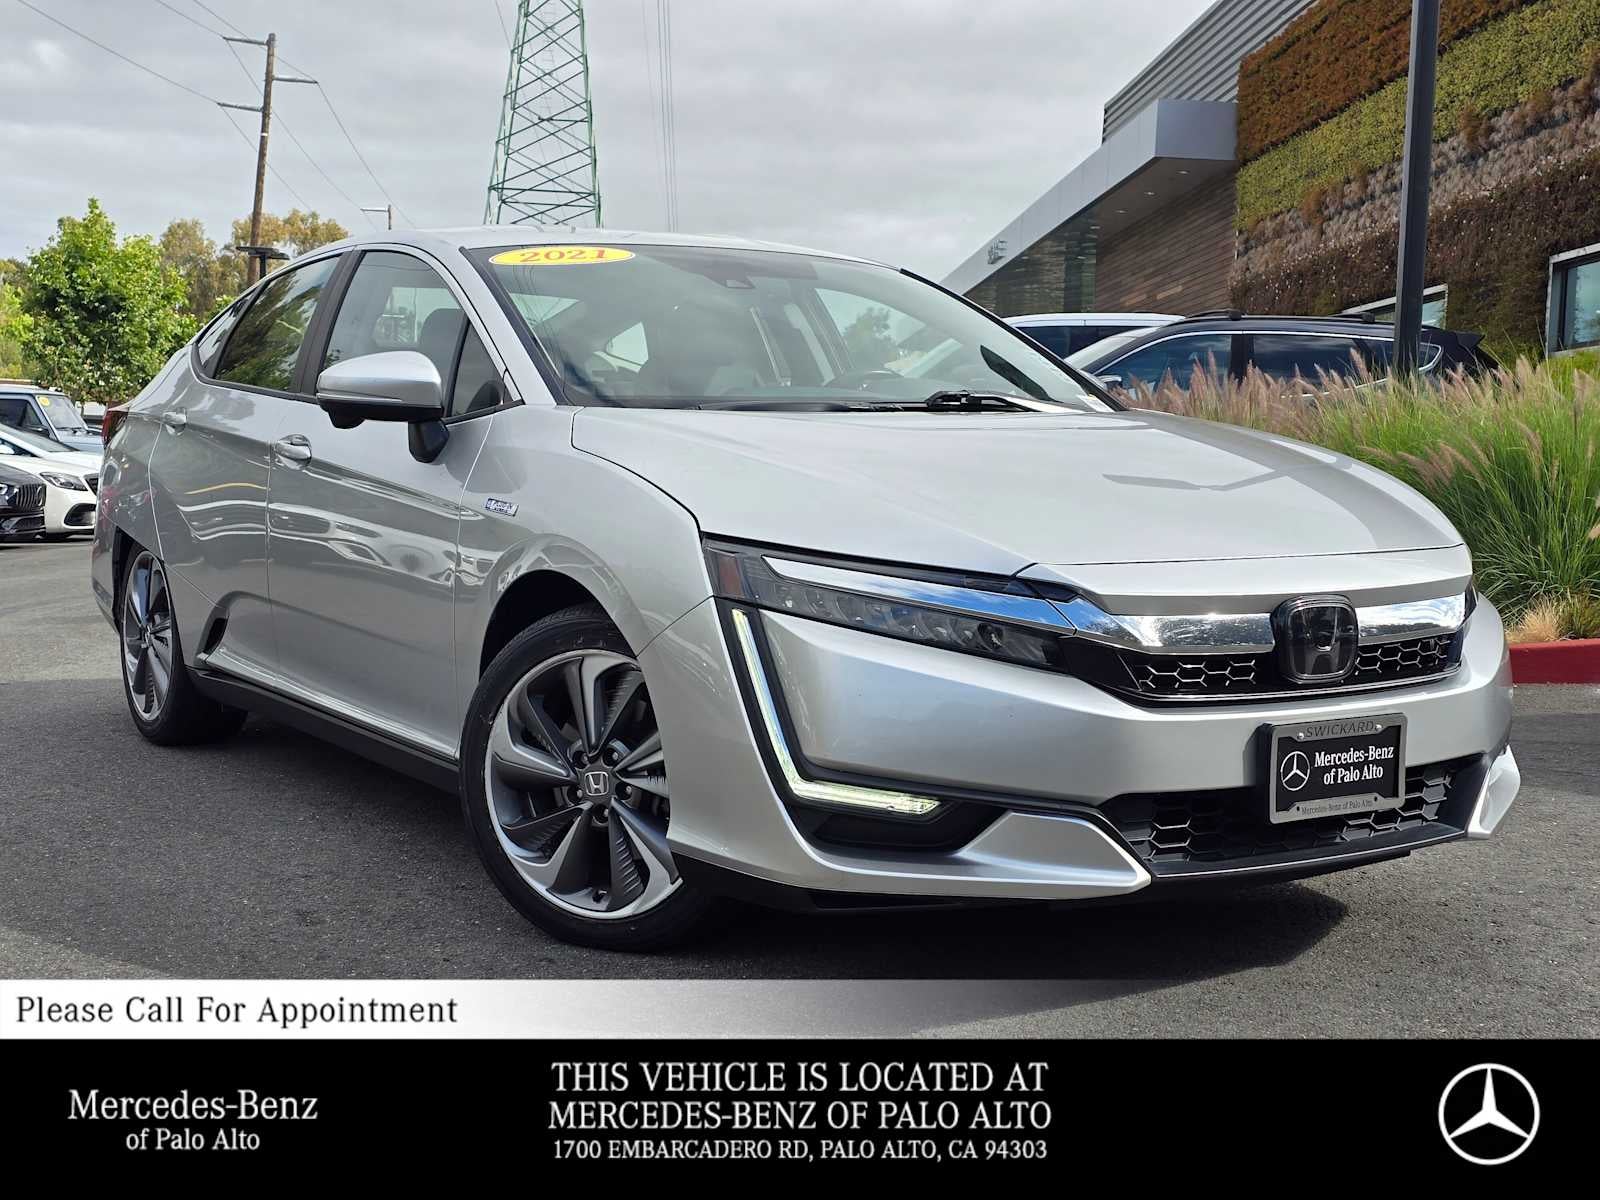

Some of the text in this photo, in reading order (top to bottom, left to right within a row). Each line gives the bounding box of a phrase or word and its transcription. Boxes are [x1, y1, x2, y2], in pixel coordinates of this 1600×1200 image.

[519, 249, 607, 263] 2021
[1306, 720, 1374, 738] SWICKARD
[1314, 745, 1394, 768] Mercedes-Benz
[1323, 763, 1384, 785] of Palo Alto
[1301, 802, 1342, 816] Merced-Benz
